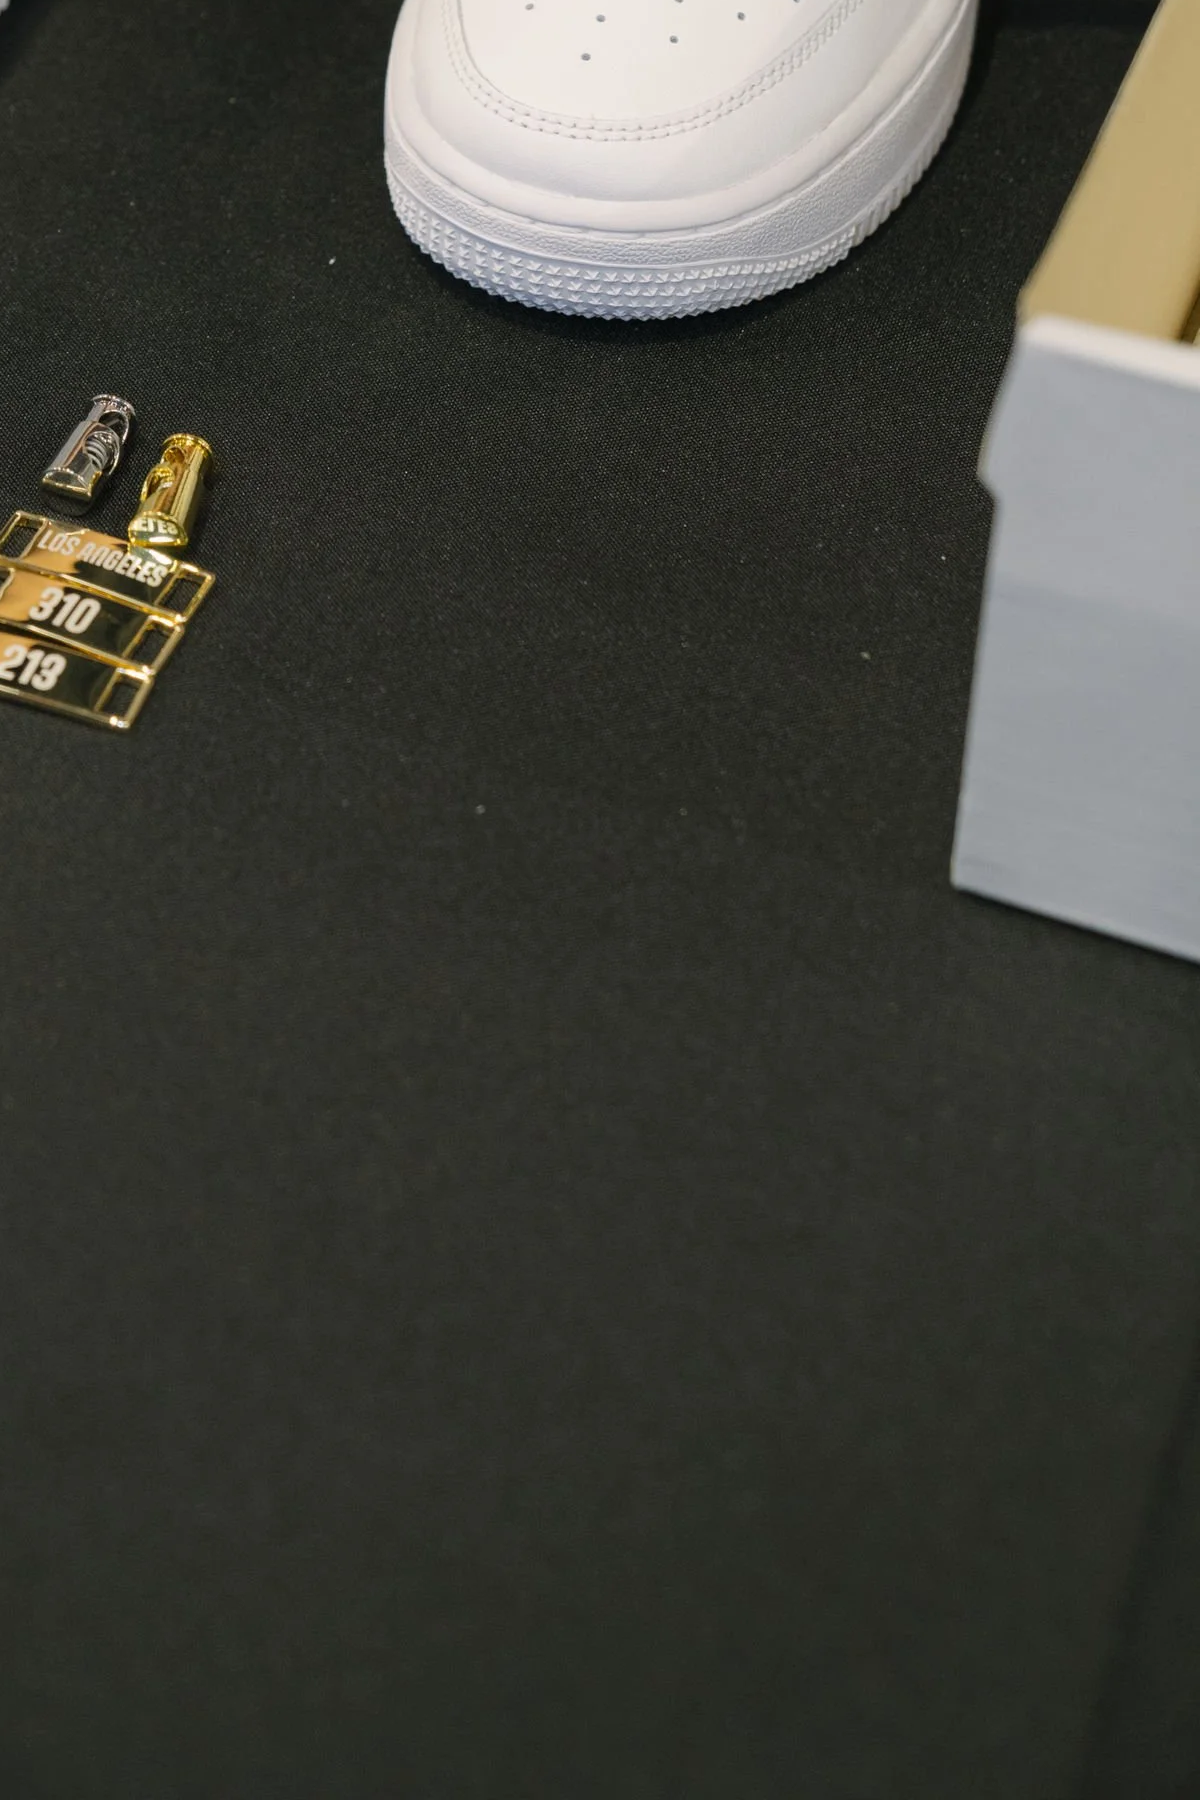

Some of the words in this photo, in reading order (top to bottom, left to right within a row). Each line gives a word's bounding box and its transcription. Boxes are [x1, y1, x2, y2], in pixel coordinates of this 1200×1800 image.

[37, 529, 81, 556] LOS
[75, 542, 169, 587] ANGELES
[28, 585, 101, 634] 310
